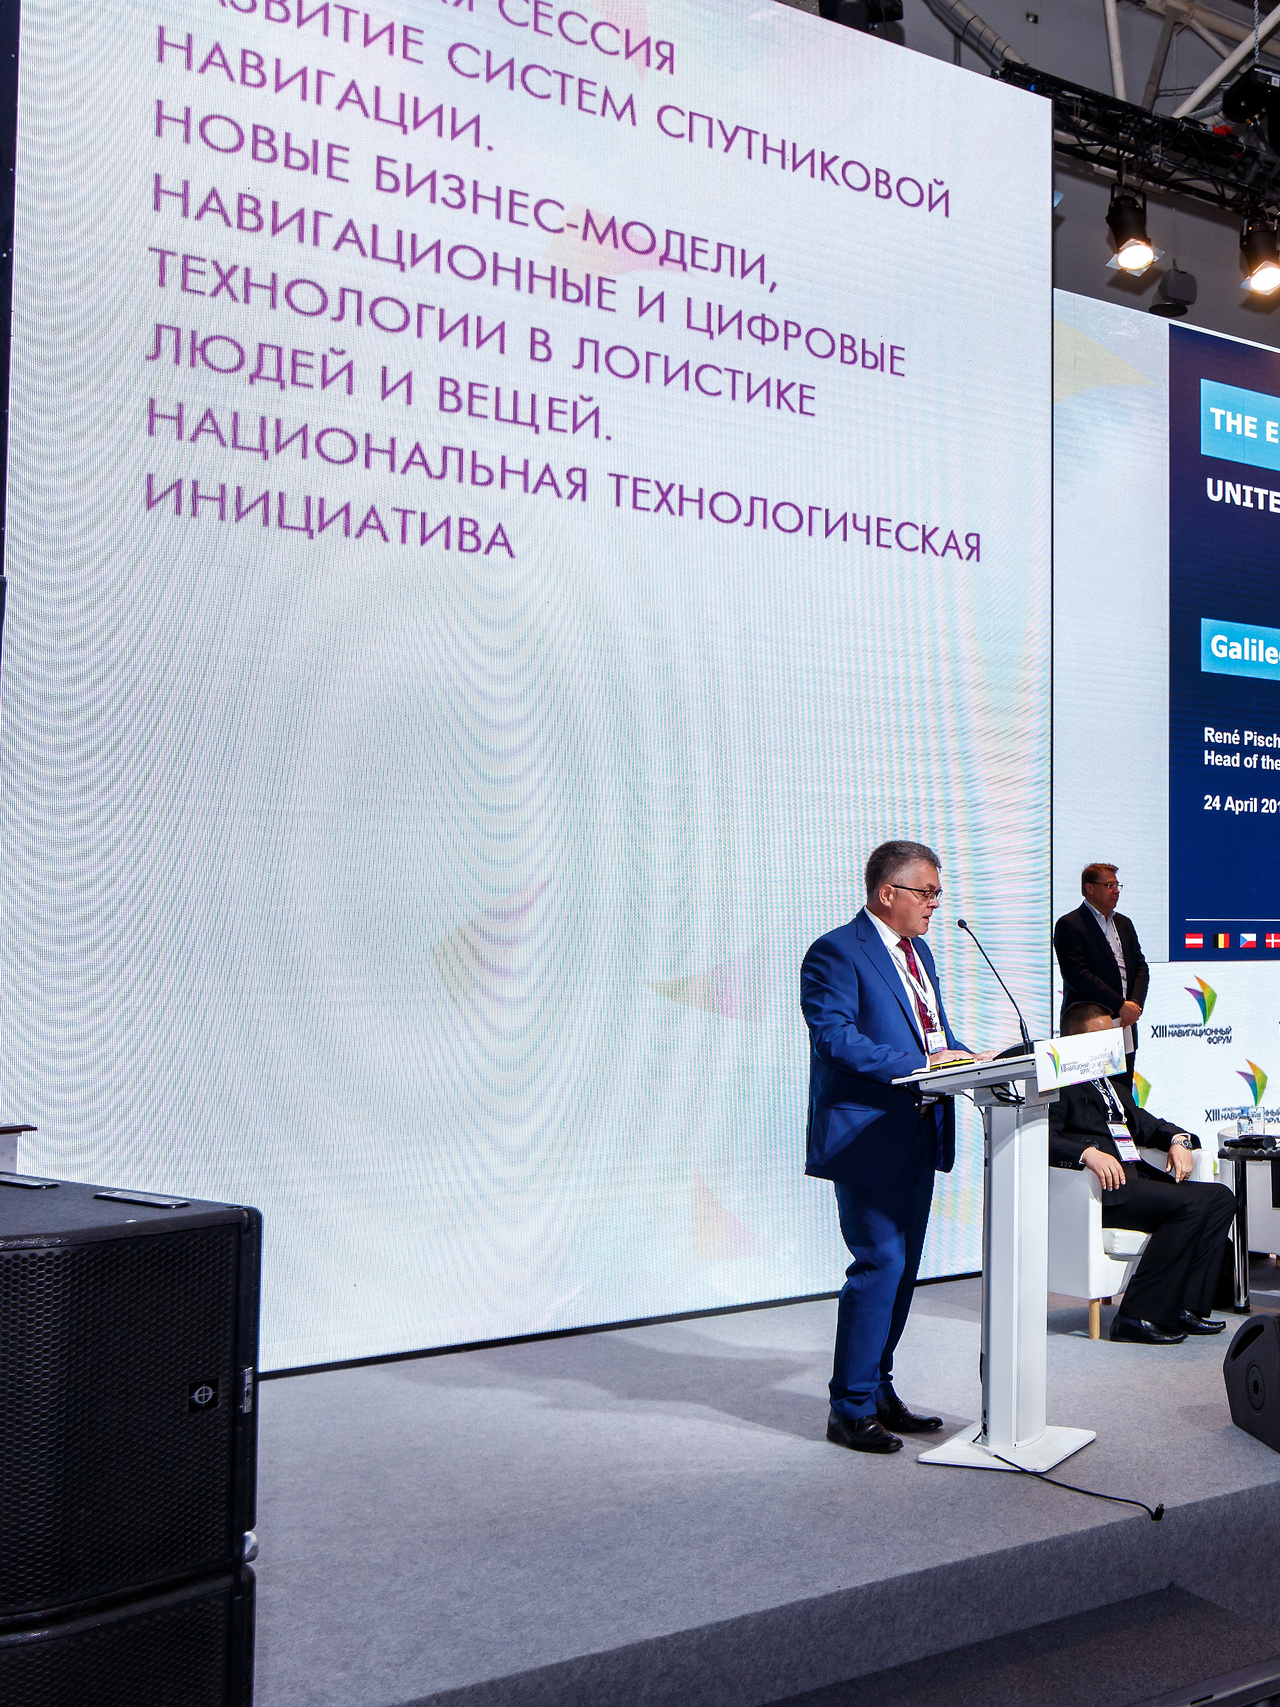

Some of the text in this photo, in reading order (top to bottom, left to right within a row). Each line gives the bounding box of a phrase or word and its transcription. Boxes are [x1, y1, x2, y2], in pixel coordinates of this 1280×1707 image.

[498, 0, 675, 75] СЕССИЯ
[157, 25, 493, 151] НАВИГАЦИИ.
[219, 0, 950, 218] ВИТИЕ СИСТЕМ СПУТНИКОВОЙ
[156, 99, 777, 293] НОВЫЕ БИЗНЕС-МОДЕЛИ,
[154, 172, 906, 377] НАВИГАЦИОННЫЕ И ЦИФРОВЫЕ
[148, 246, 816, 417] ТЕХНОЛОГИИ В ЛОГИСТИКЕ
[146, 323, 613, 441] ЛЮДЕЙ И ВЕЩЕЙ.
[1209, 407, 1258, 439] THE
[146, 473, 516, 559] ИНИЦИАТИВА
[148, 397, 982, 563] НАЦИОНАЛЬНАЯ ТЕХНОЛОГИЧЕСКАЯ
[1203, 726, 1240, 745] René
[1203, 750, 1241, 768] Head
[1243, 753, 1259, 770] of
[1203, 794, 1222, 810] 24
[1223, 795, 1258, 815] April
[1151, 1025, 1232, 1038] XIII НАВИГАЦИОННЫЙ
[1207, 1035, 1232, 1044] ФОРУМ
[1204, 1109, 1220, 1122] XIII
